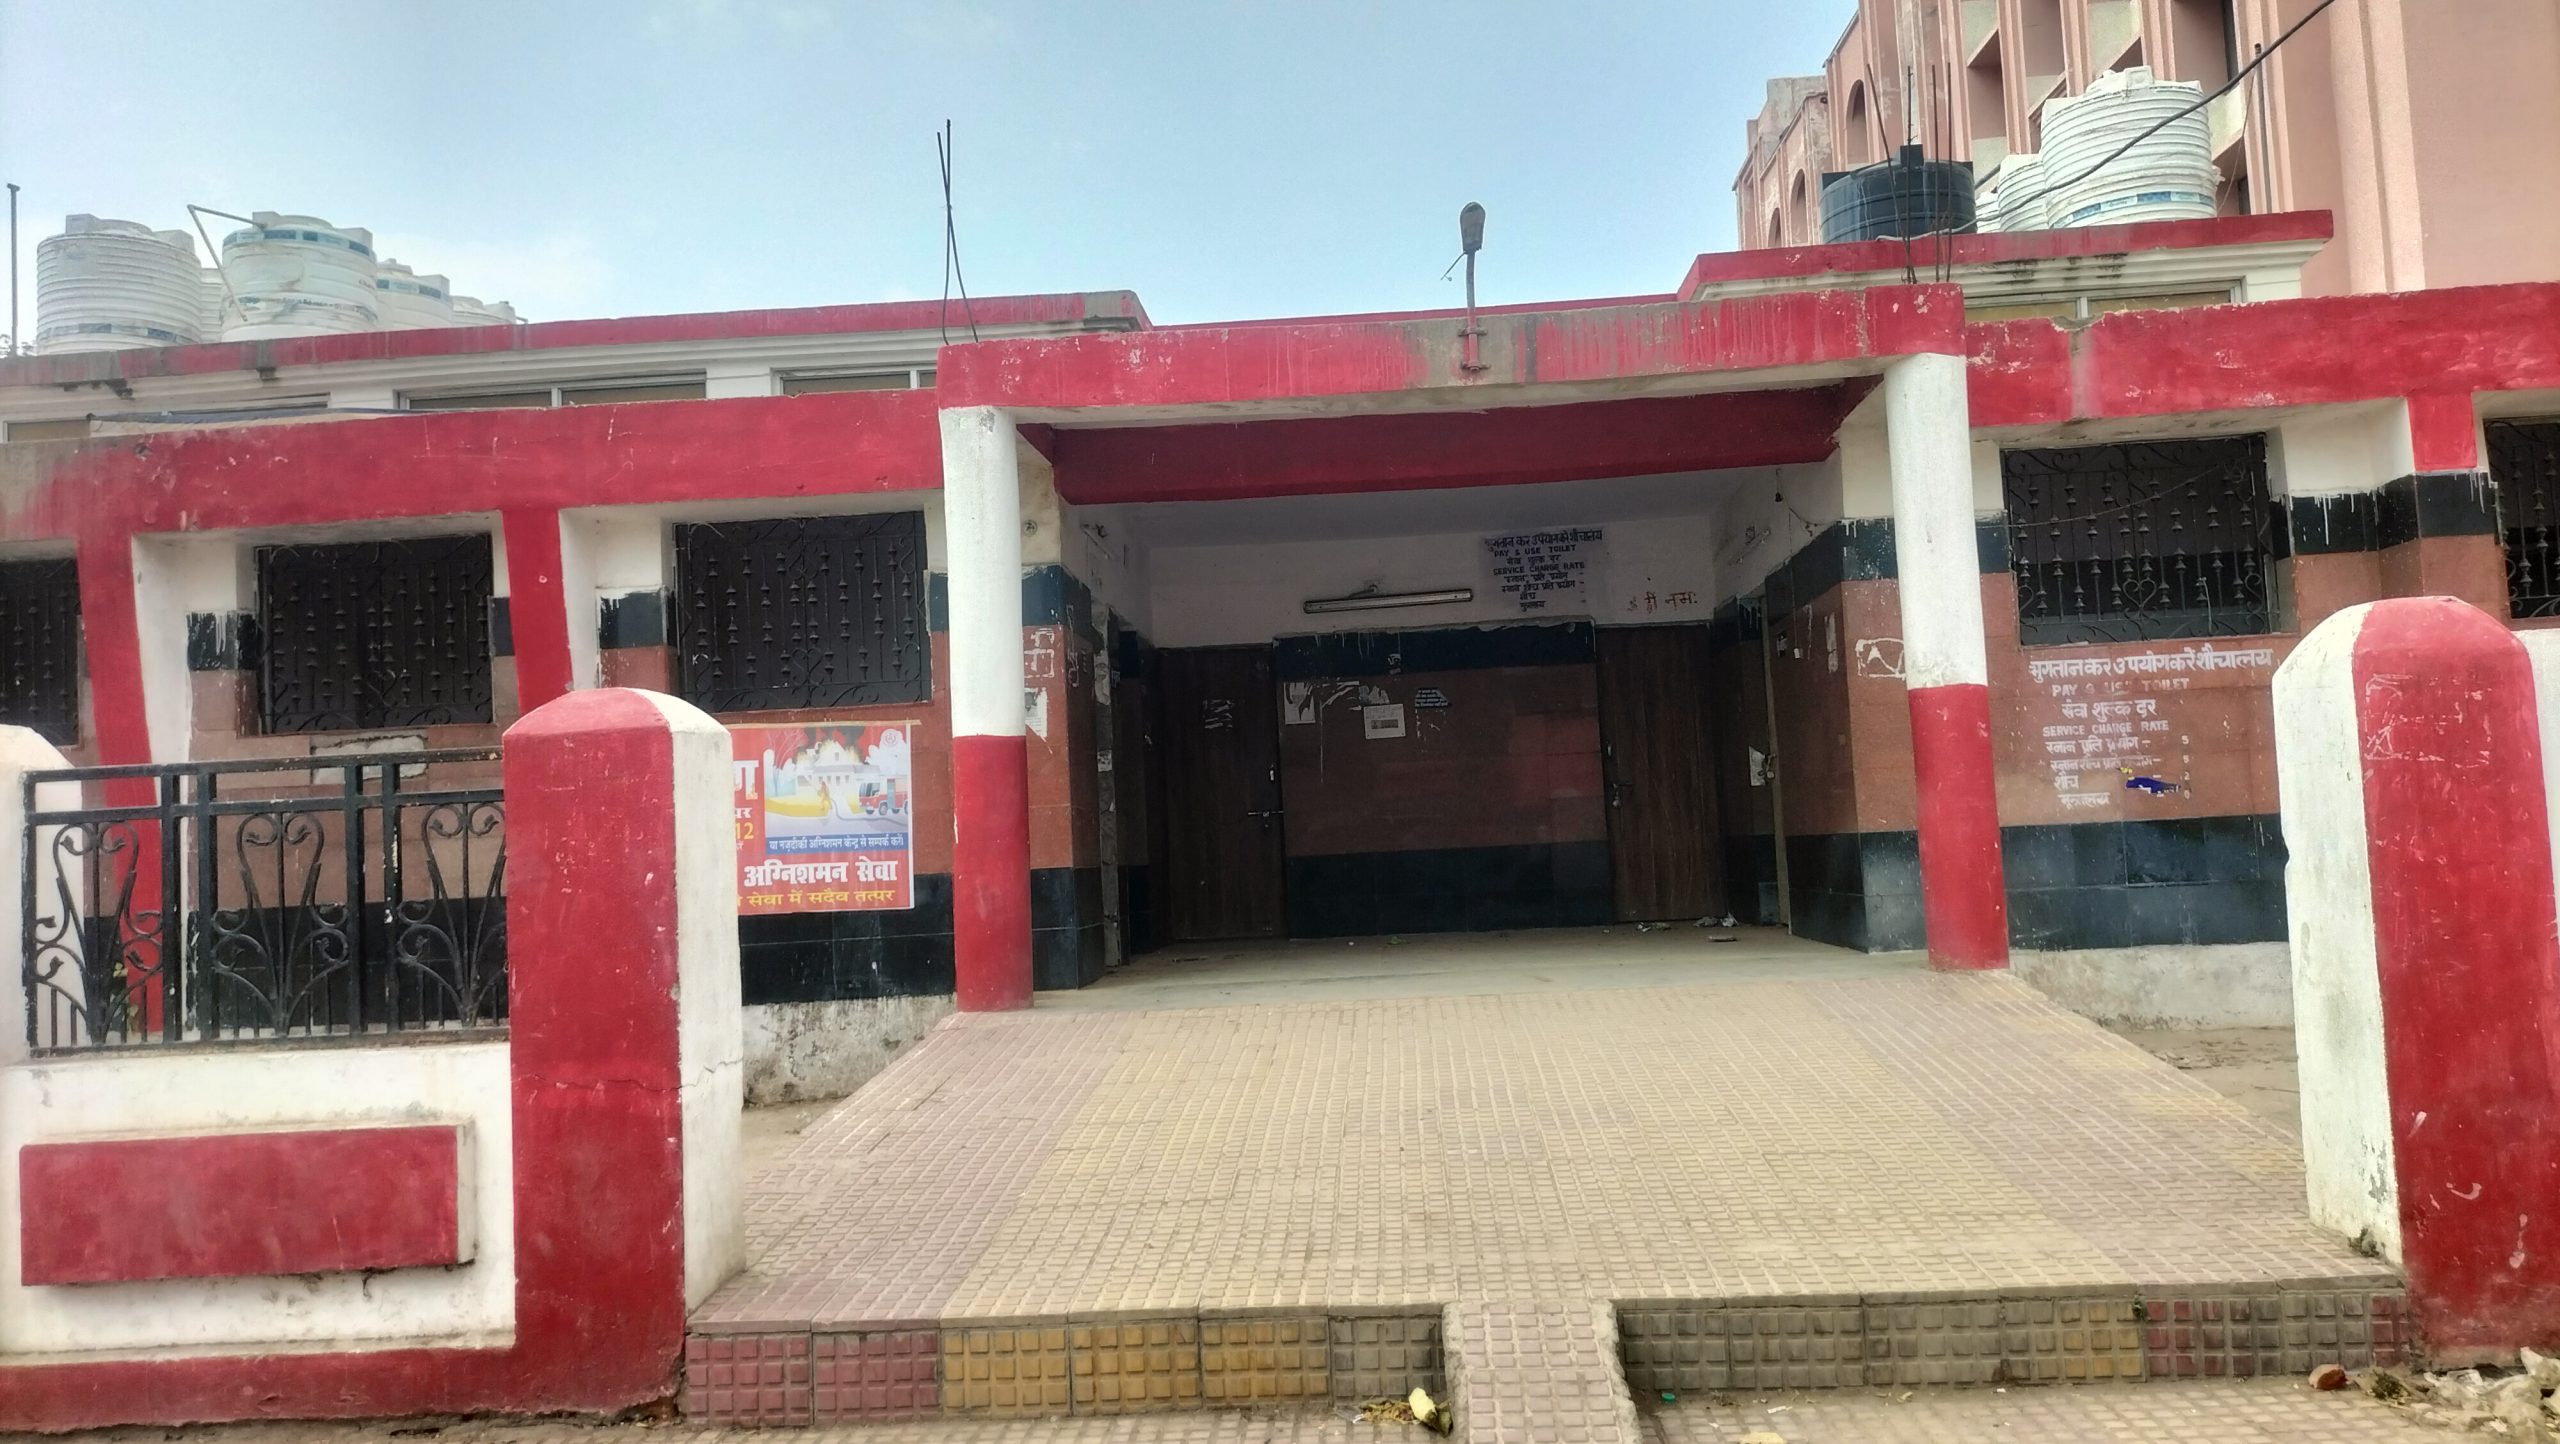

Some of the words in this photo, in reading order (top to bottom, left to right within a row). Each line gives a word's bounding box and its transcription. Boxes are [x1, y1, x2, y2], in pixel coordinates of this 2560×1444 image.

[1524, 547, 1541, 555] USE
[1548, 544, 1576, 553] TOILET
[1493, 566, 1525, 576] SERVICE
[1529, 563, 1559, 573] CHARGE
[1563, 561, 1585, 570] RATE
[2112, 650, 2170, 675] उपयोग
[2196, 643, 2274, 670] शौचालय
[2052, 683, 2078, 697] PAY
[2135, 699, 2157, 718] दर
[2042, 725, 2085, 737] SERVICE
[2078, 735, 2103, 754] प्रति
[2181, 735, 2190, 745] 5
[769, 840, 778, 849] या
[809, 837, 843, 849] अग्निशमन
[860, 837, 867, 847] से
[744, 858, 849, 888] अग्निशमन
[855, 855, 899, 882] सेवा
[747, 890, 784, 907] सेवा
[787, 889, 803, 904] में
[807, 887, 850, 904] सदैव
[853, 889, 896, 902] तत्पर
